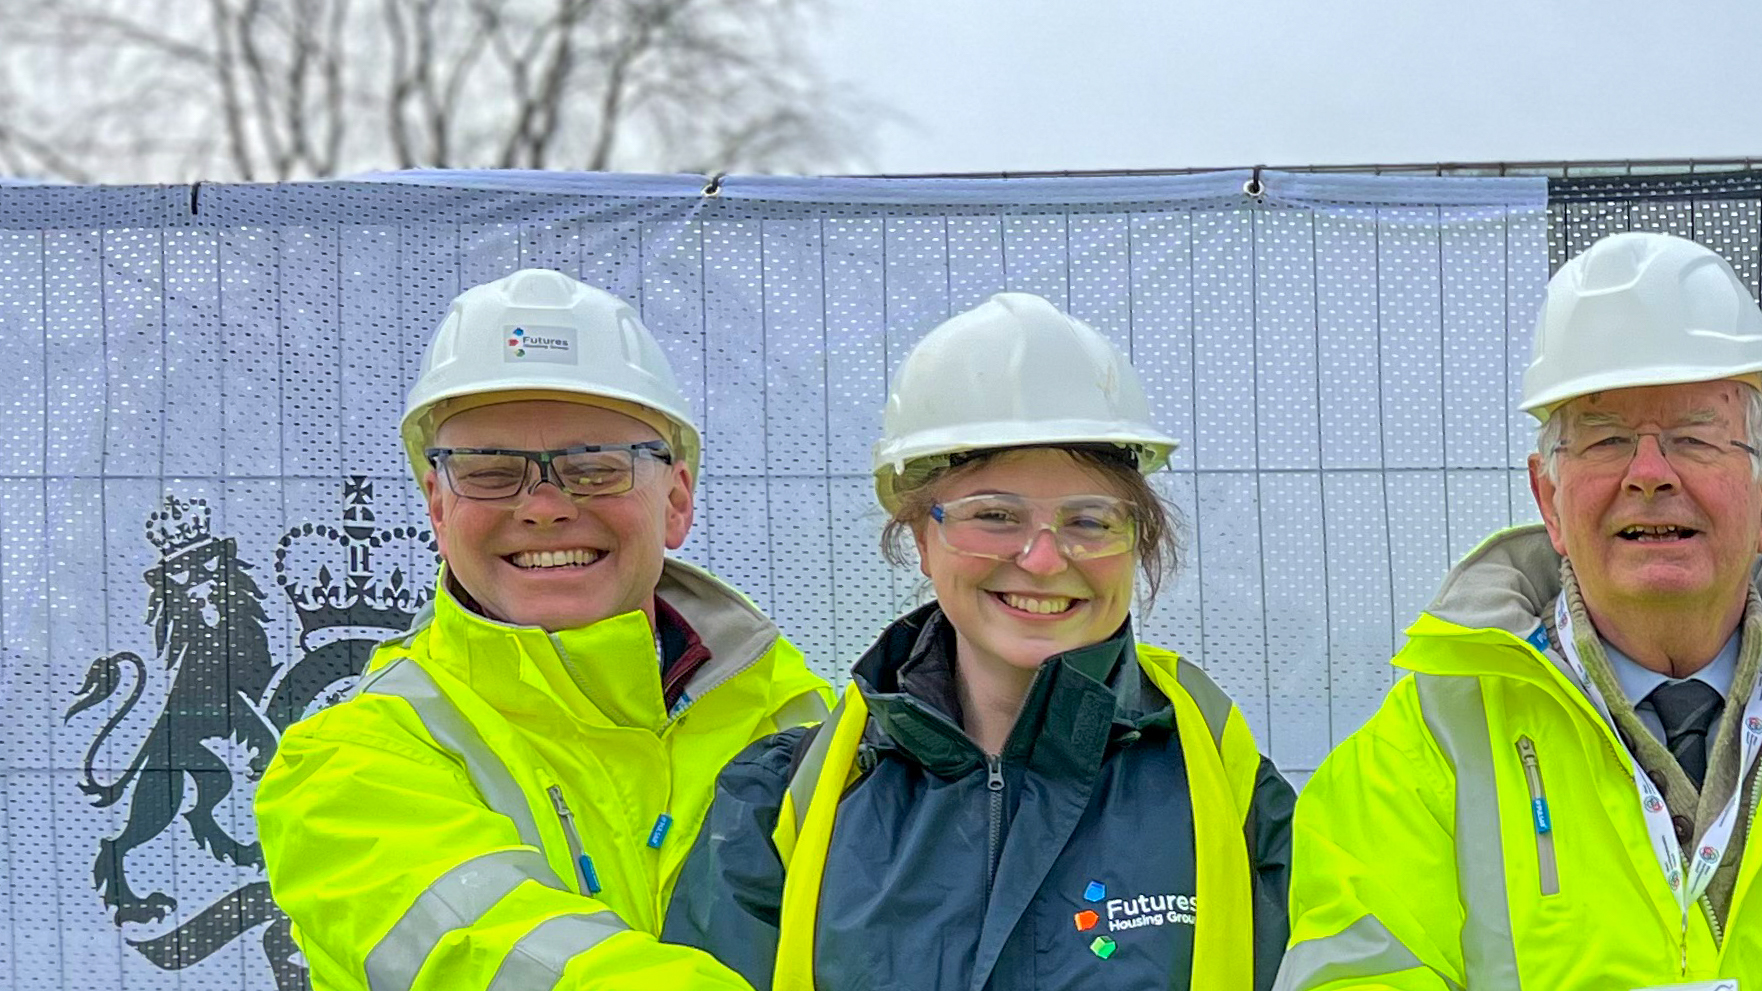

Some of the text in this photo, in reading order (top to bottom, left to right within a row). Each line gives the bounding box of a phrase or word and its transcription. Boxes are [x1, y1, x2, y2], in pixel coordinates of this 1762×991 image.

[523, 336, 569, 347] Futures
[1106, 894, 1197, 920] Futures
[1108, 911, 1197, 932] Housing Grou
